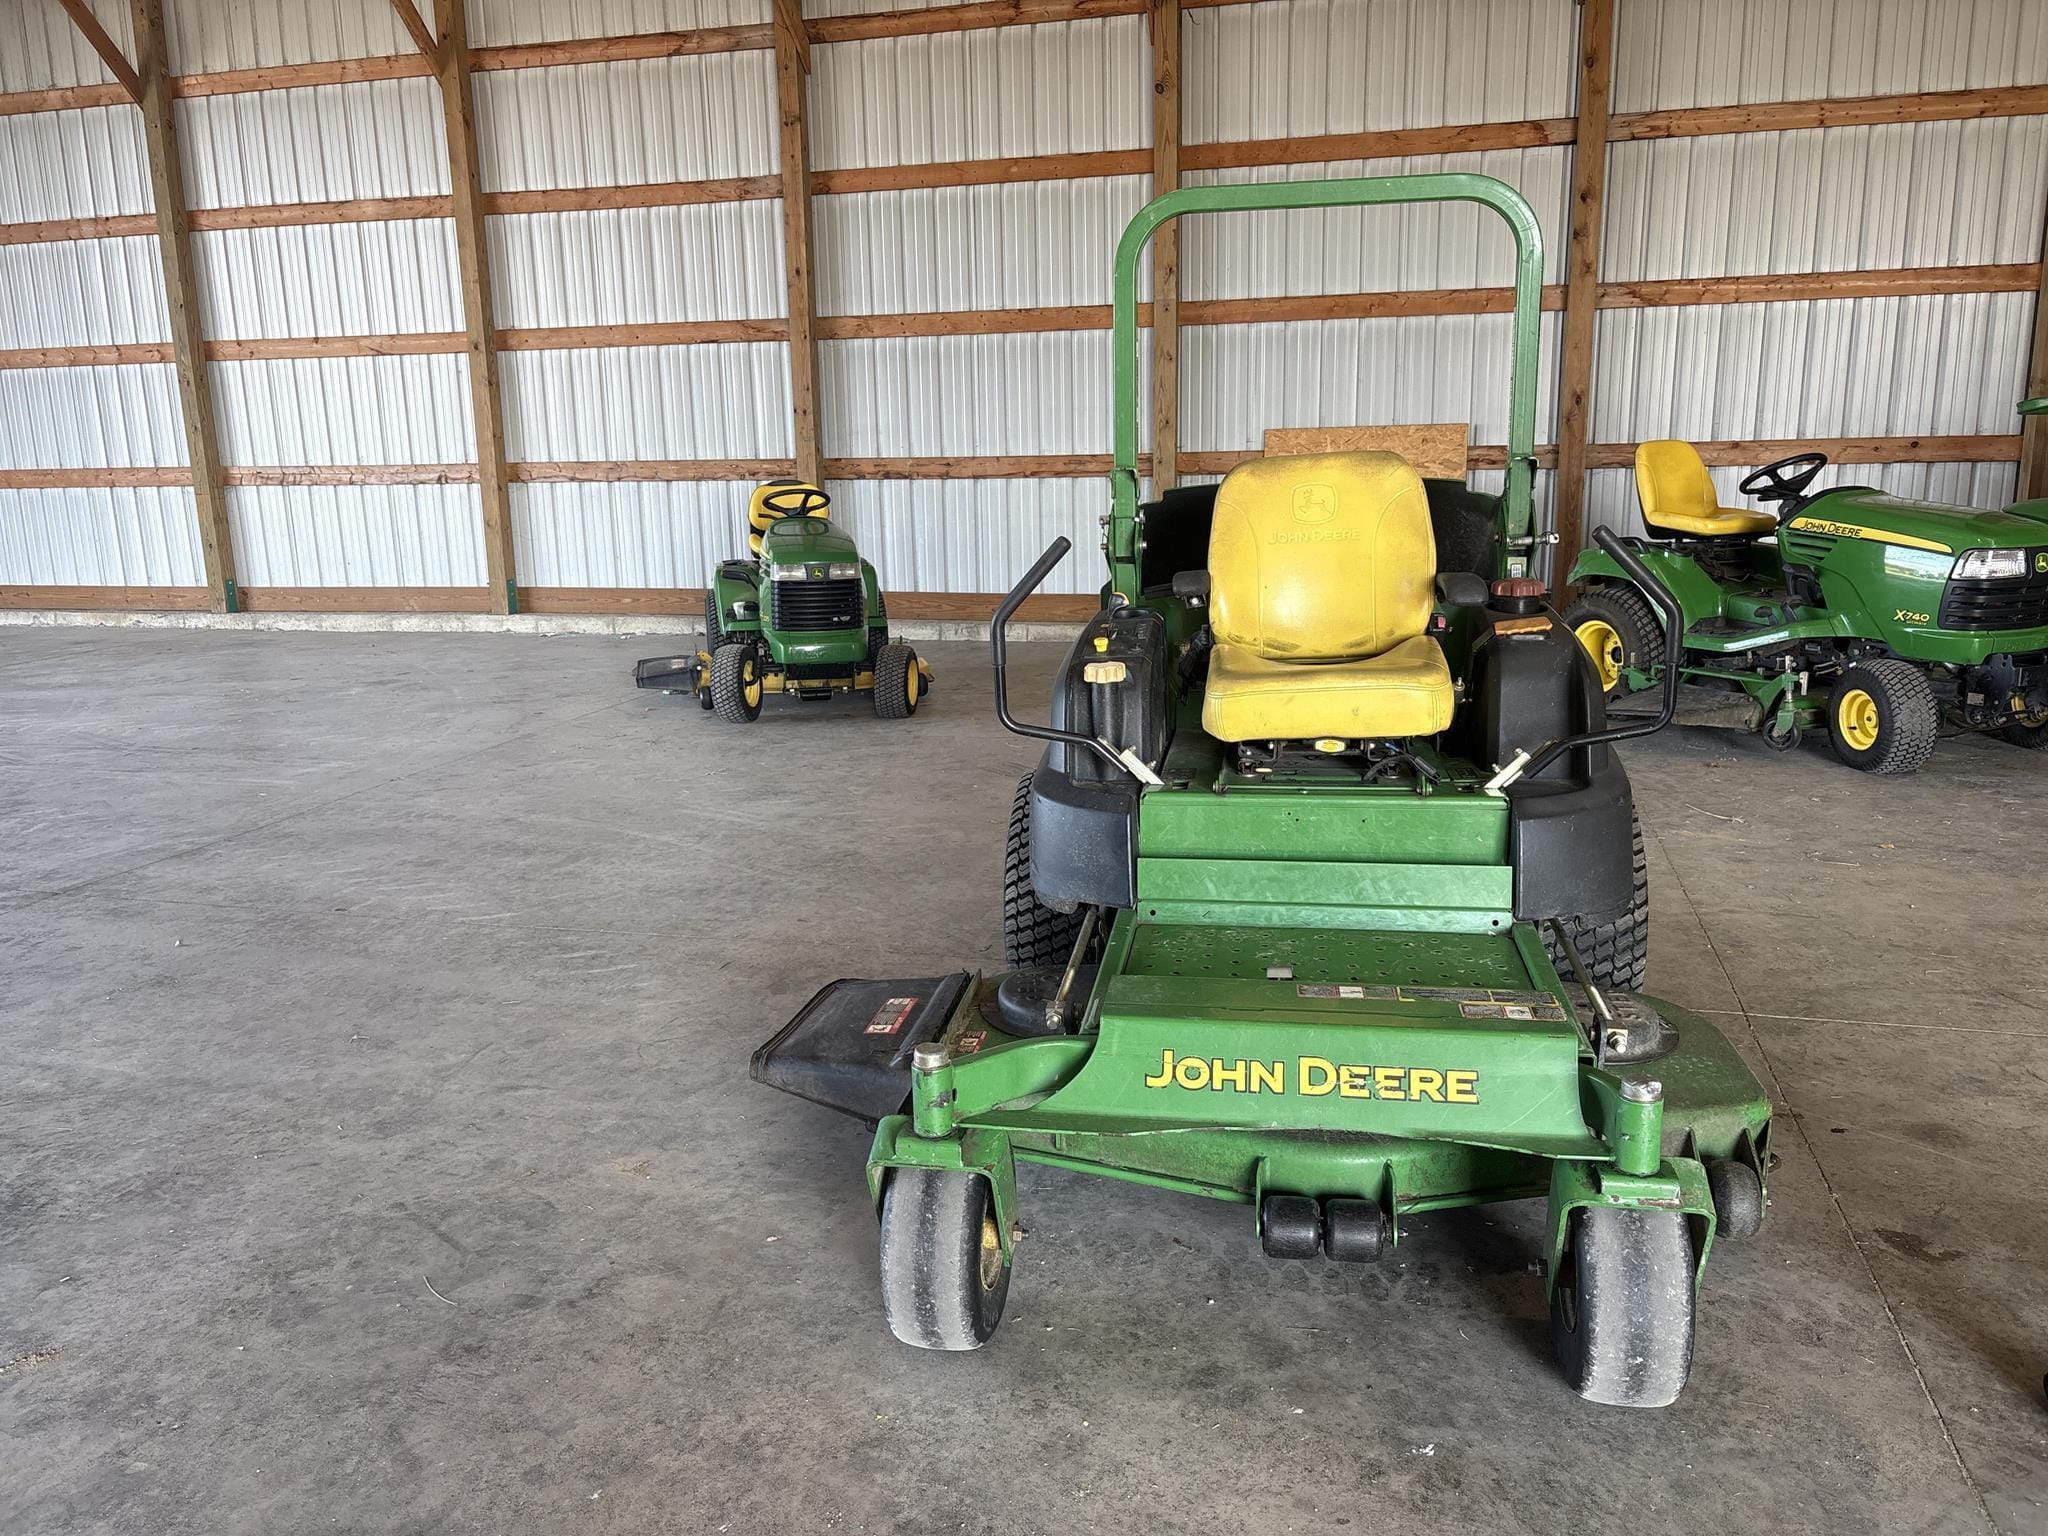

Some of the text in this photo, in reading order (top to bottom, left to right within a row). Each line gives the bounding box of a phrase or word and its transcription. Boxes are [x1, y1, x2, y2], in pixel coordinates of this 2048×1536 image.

[1800, 519, 1863, 537] JOHN DEERE
[1267, 531, 1309, 545] JOHN
[1892, 609, 1931, 622] X740
[1145, 1048, 1480, 1104] JOHN DEERE
